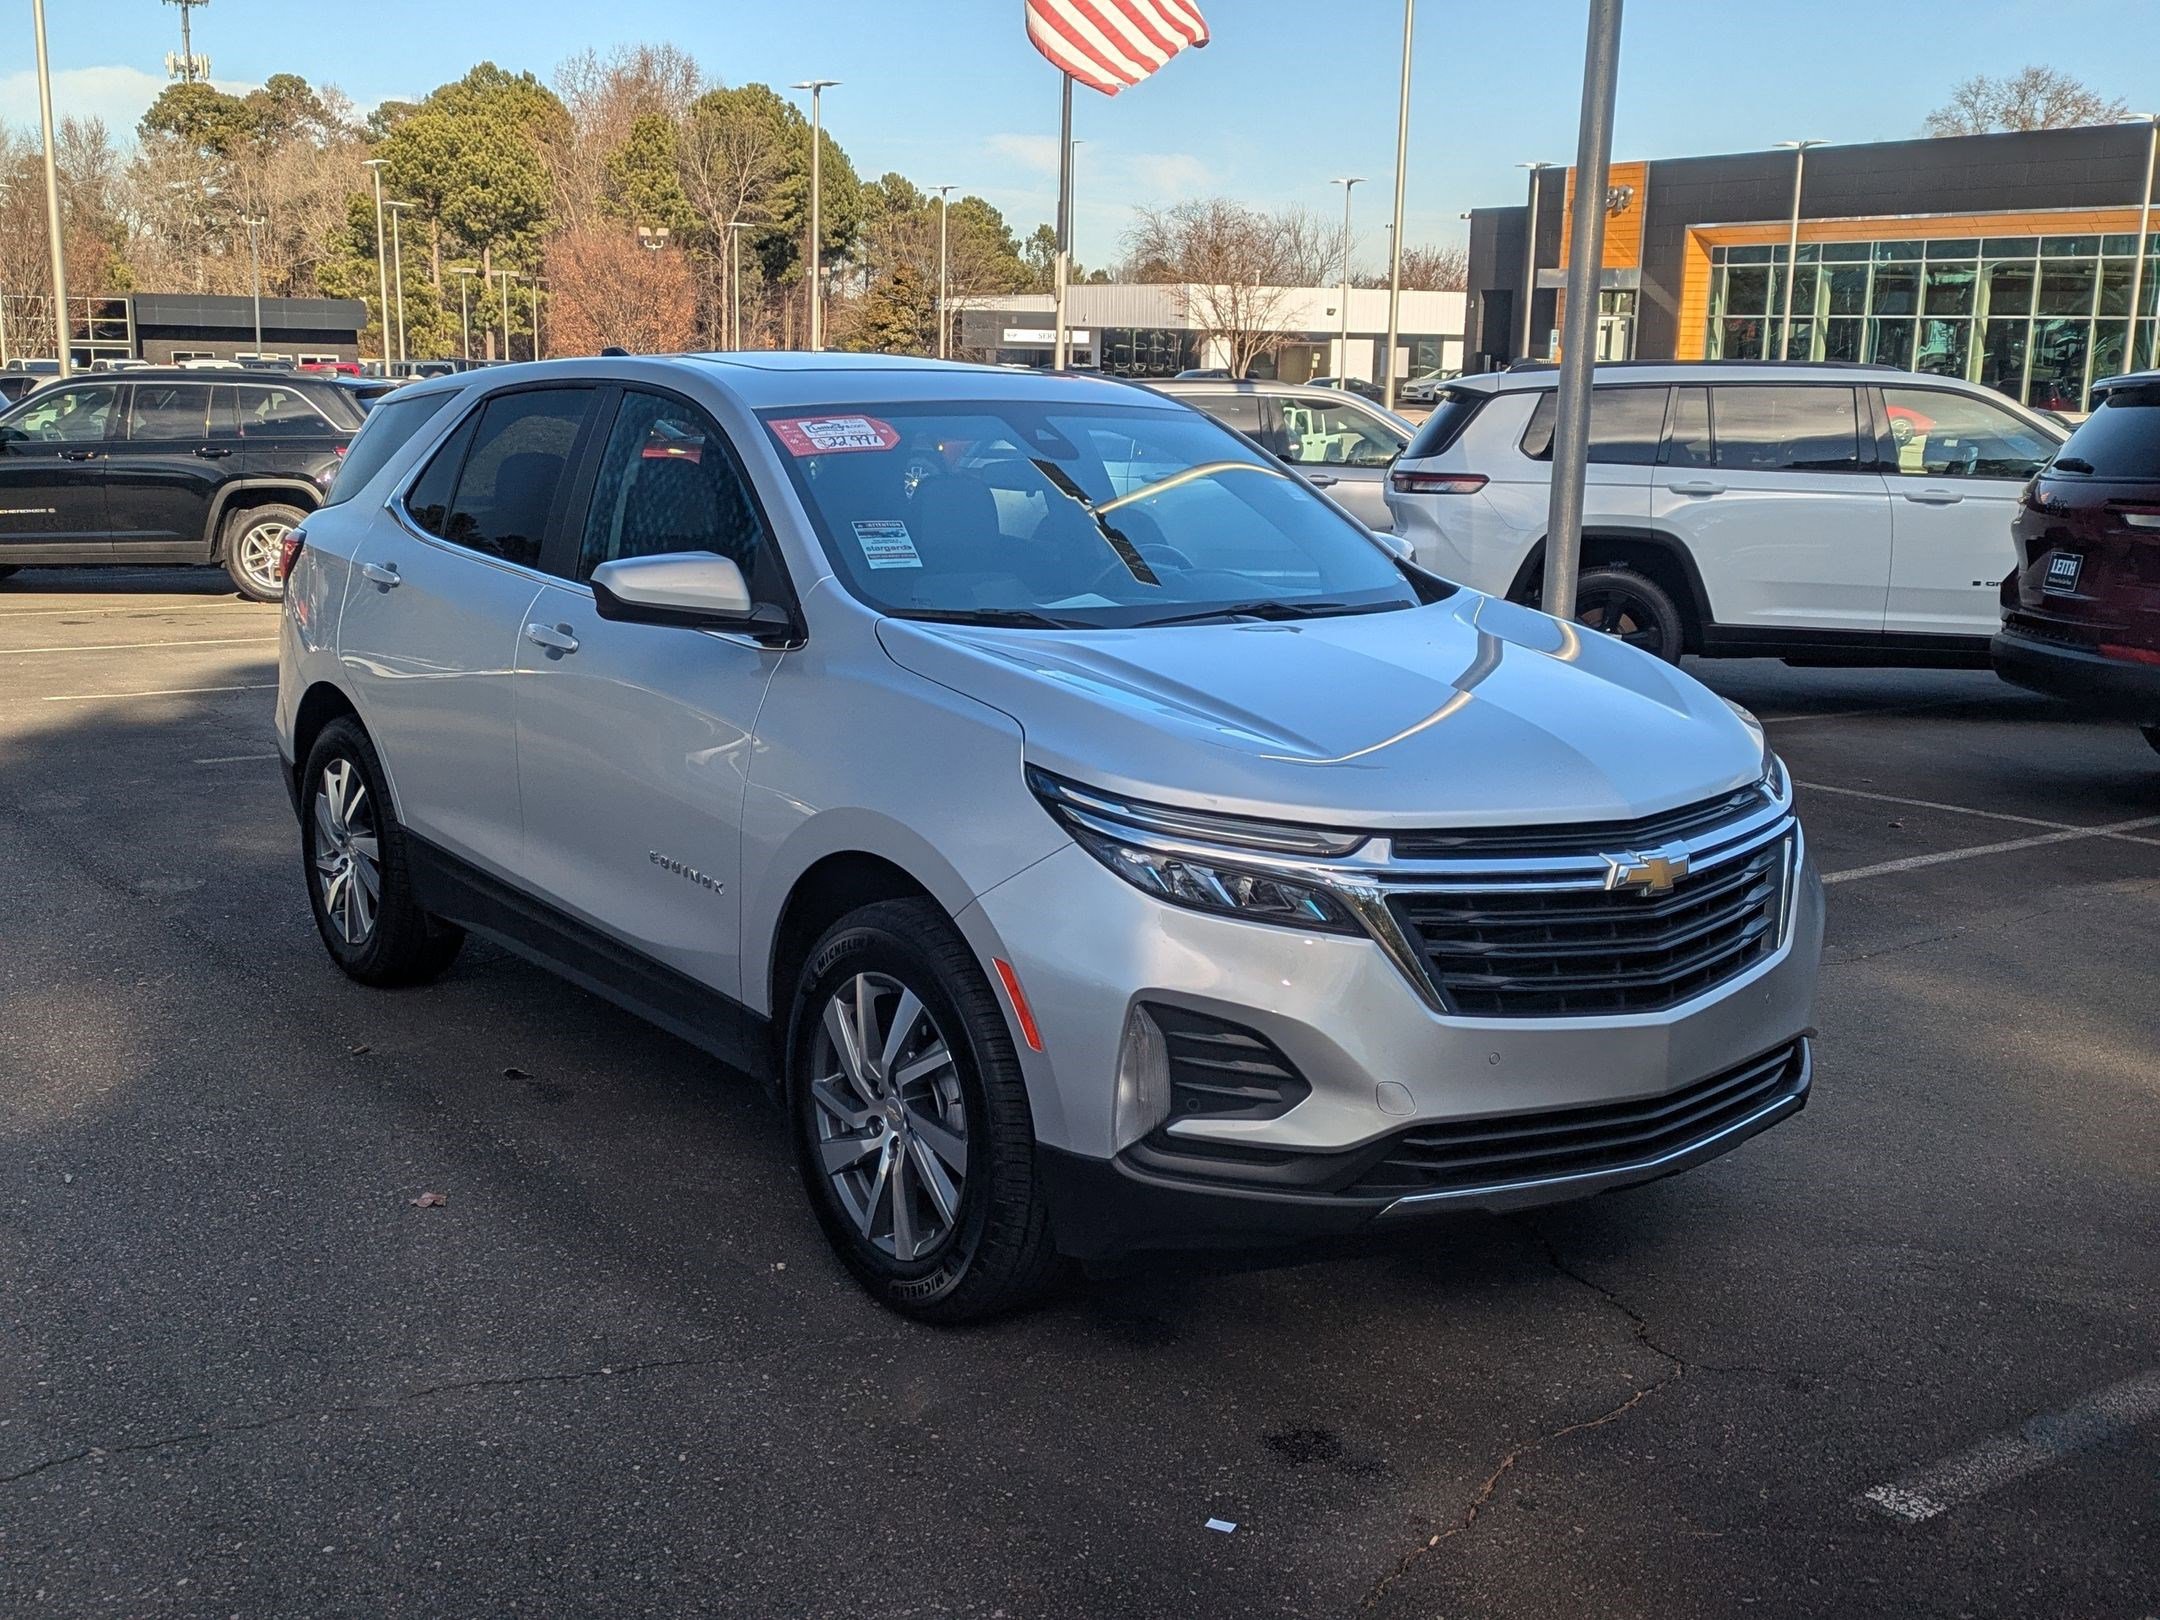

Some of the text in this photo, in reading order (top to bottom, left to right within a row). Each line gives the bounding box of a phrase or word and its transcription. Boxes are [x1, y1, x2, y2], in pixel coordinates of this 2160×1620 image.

[2050, 559, 2077, 576] LEITH
[649, 850, 724, 895] EQUINOX
[891, 1272, 945, 1298] MICHELIN
